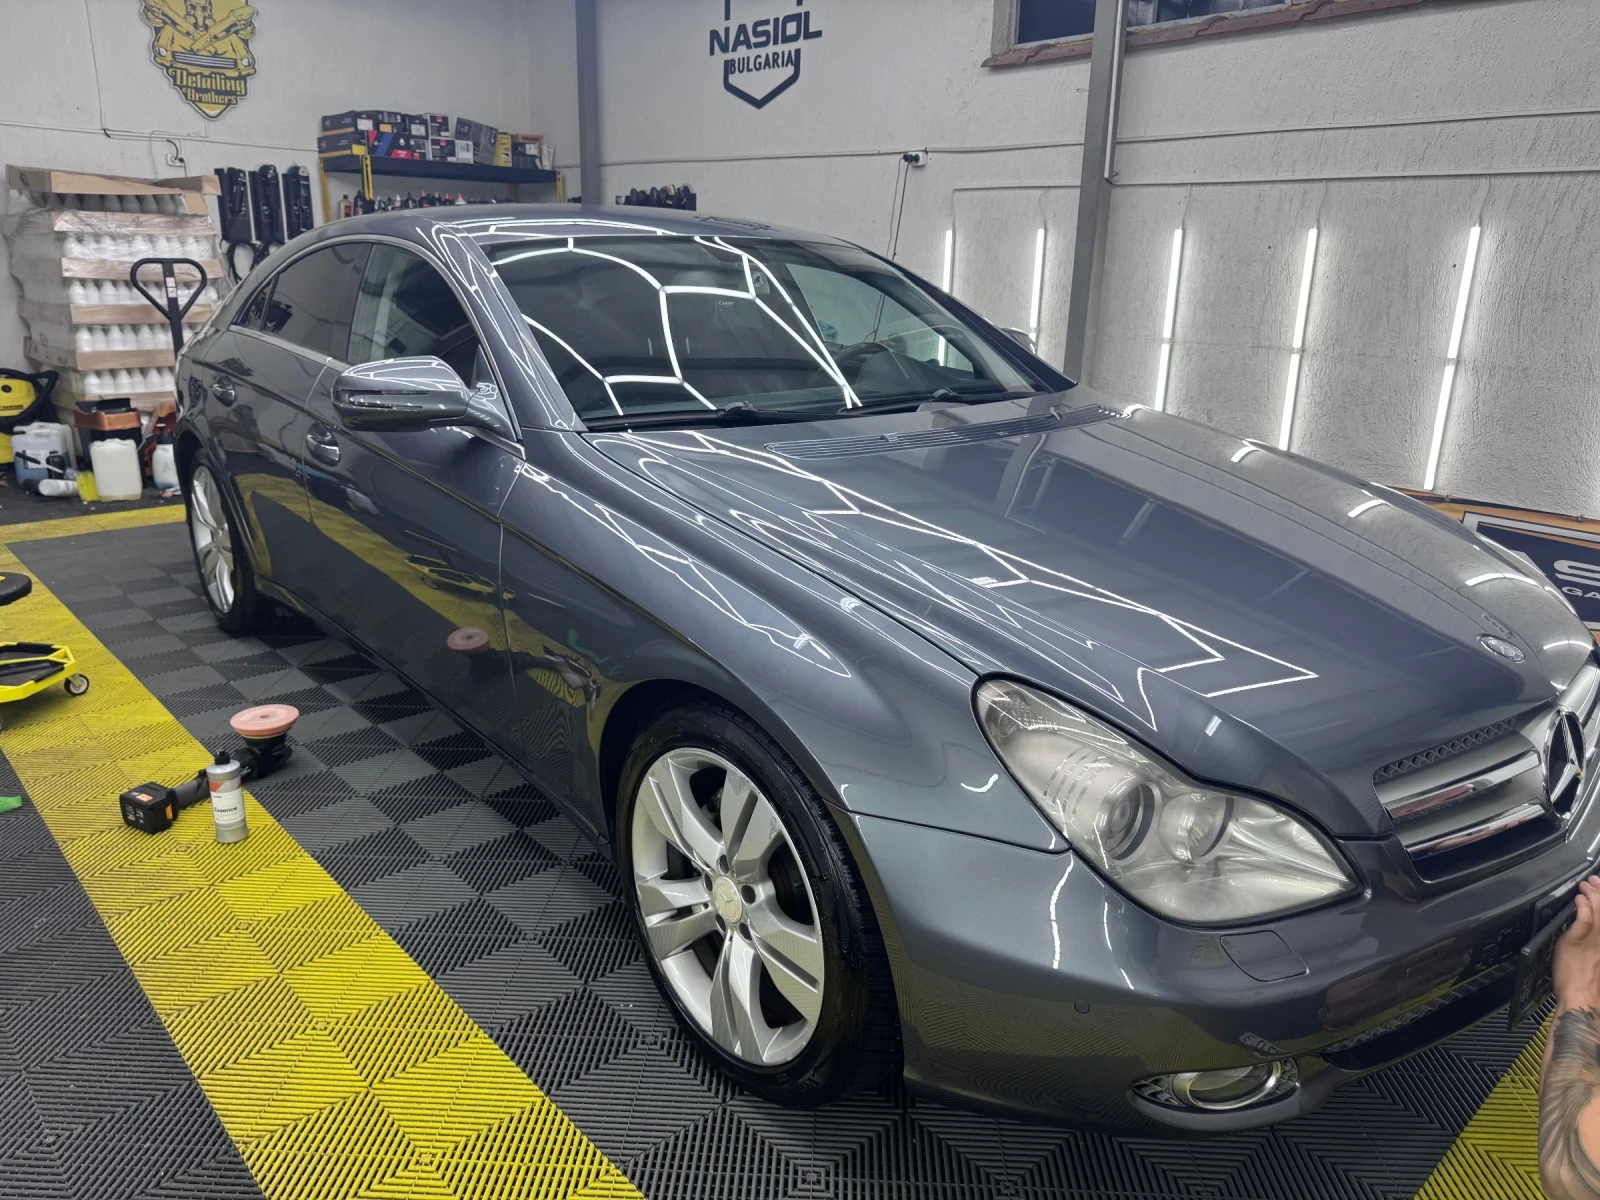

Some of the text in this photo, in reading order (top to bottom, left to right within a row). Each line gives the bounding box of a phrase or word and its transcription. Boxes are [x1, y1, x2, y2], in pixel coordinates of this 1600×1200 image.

[709, 10, 822, 56] NASIOL
[729, 49, 795, 75] BULGARIA
[168, 68, 245, 95] Detailing
[182, 88, 237, 104] Brothers
